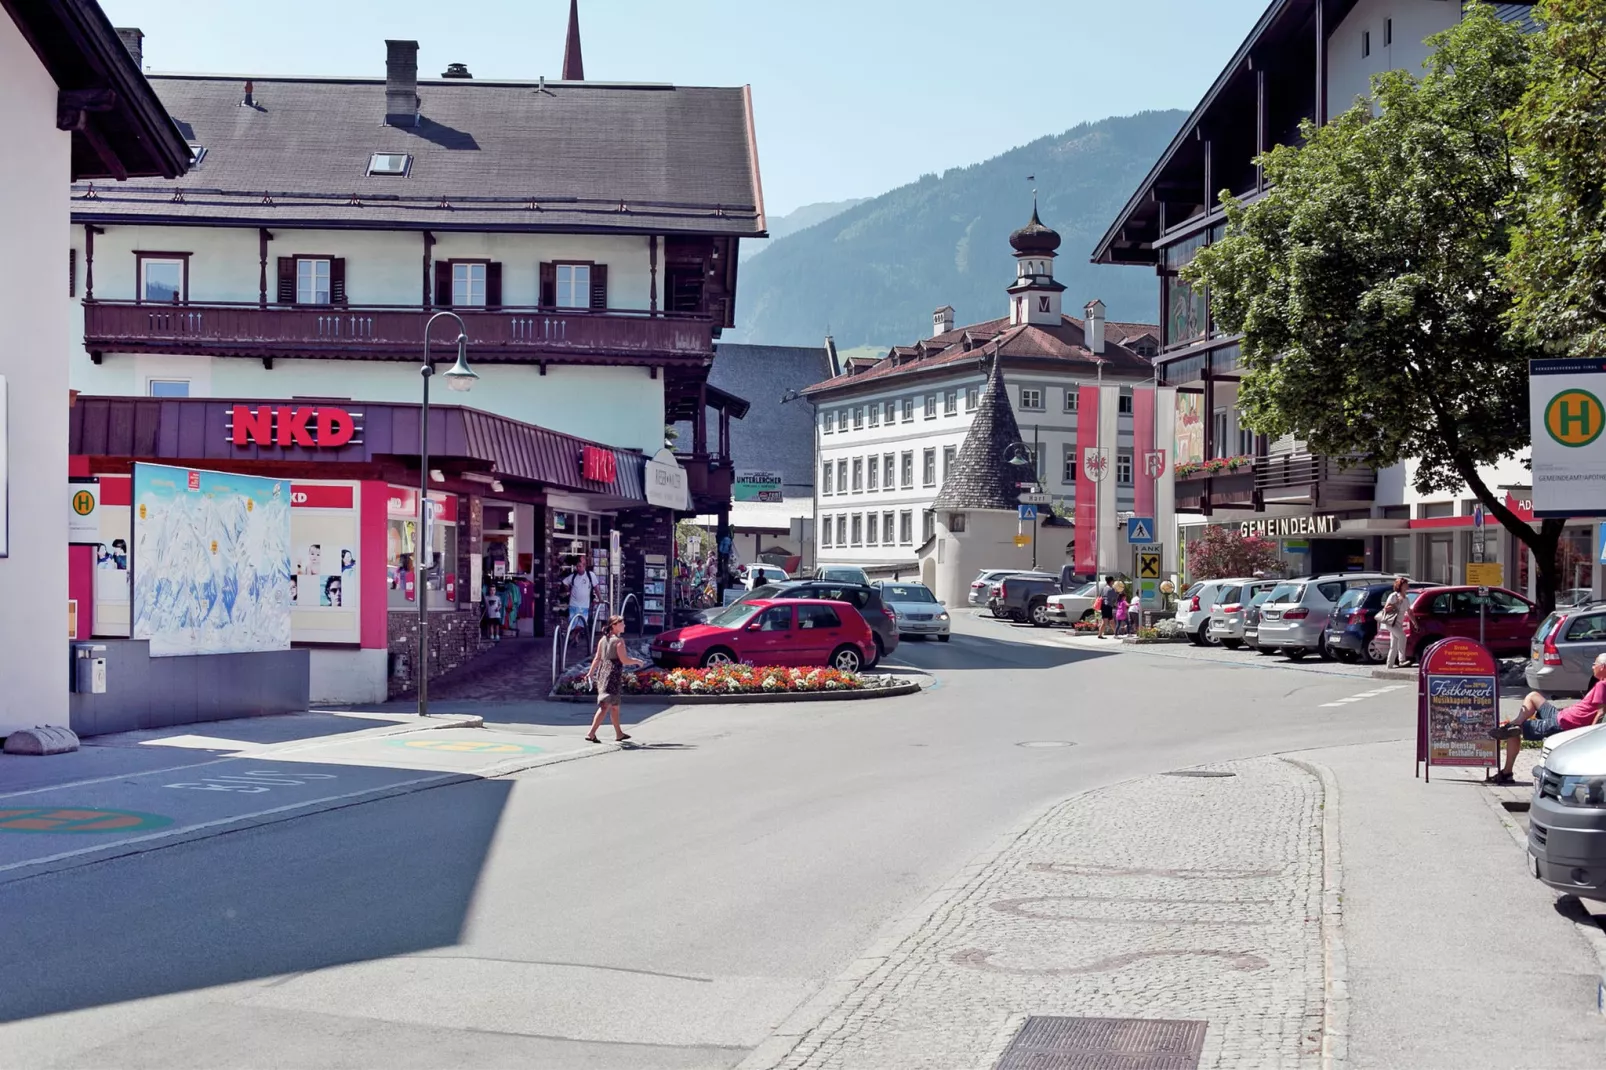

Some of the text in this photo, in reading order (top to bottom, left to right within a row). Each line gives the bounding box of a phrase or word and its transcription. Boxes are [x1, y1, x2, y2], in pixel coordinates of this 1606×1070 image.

[231, 405, 355, 447] NKD
[1559, 400, 1590, 436] H
[582, 445, 616, 483] NKD
[78, 495, 89, 511] H
[1240, 515, 1335, 538] GEMEINDEAMT
[1430, 679, 1493, 698] Festkonzert
[1448, 749, 1475, 757] Festhalle
[1475, 749, 1494, 758] Fügen
[1450, 741, 1476, 750] Dienstag
